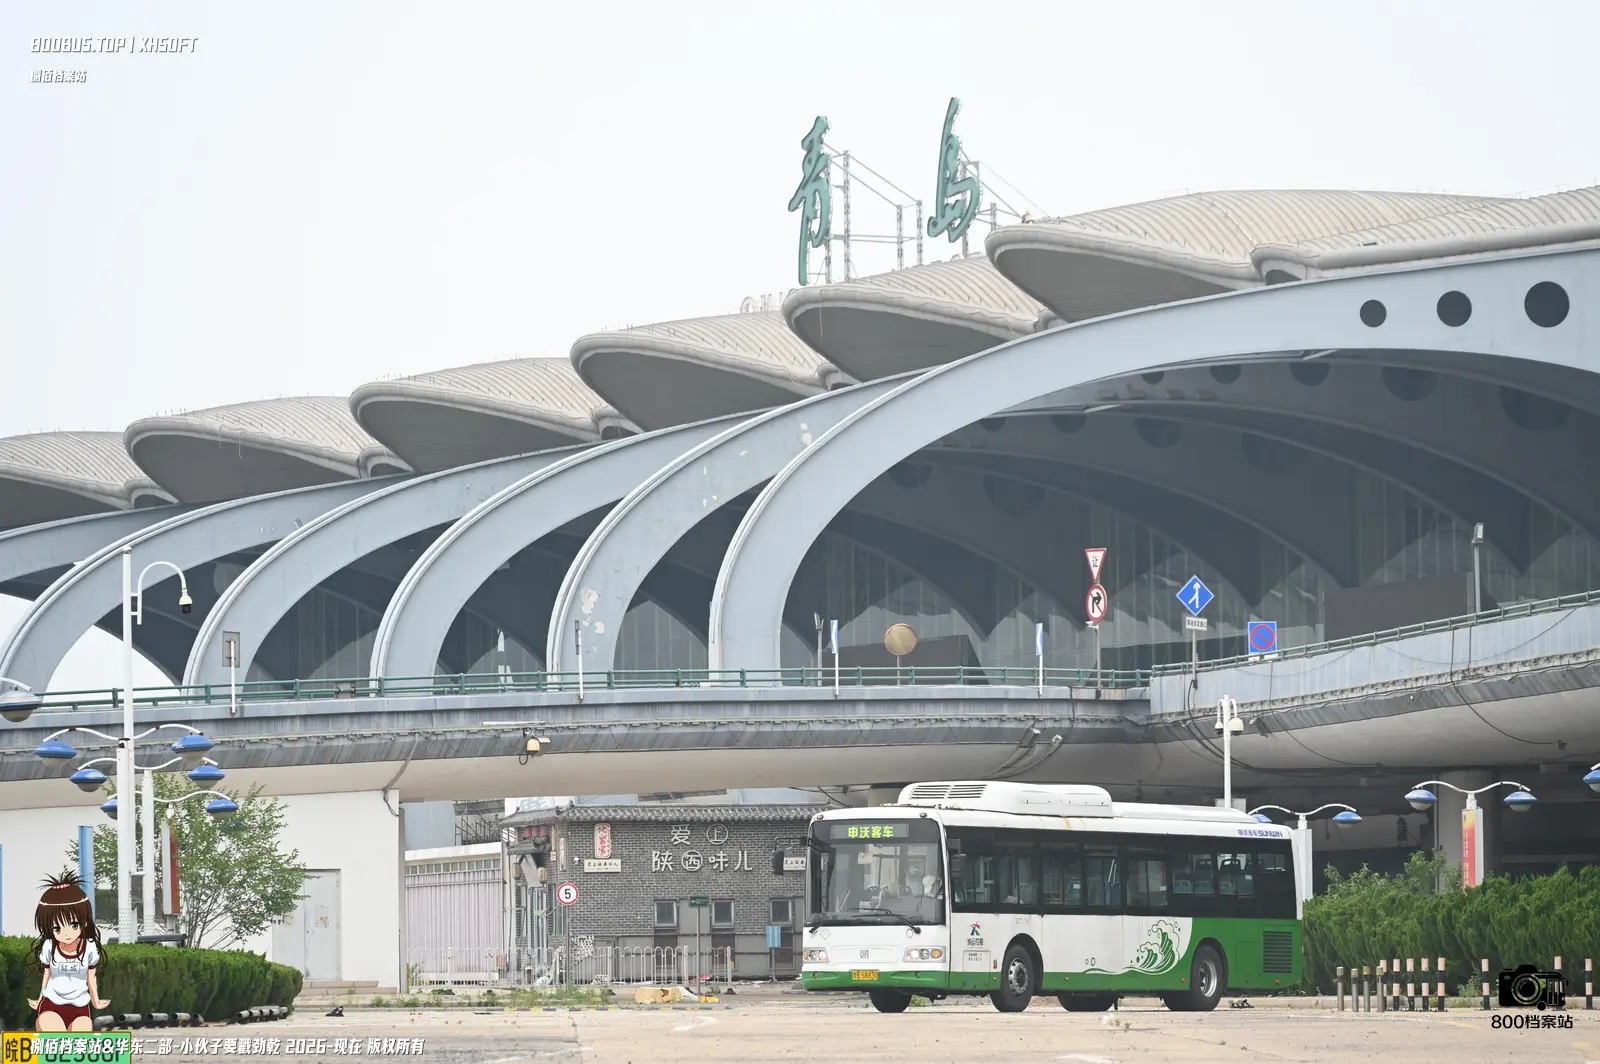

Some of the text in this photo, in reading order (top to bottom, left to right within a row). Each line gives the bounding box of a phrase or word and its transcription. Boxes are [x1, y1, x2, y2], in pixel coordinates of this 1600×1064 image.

[671, 824, 729, 845] 爱上
[848, 826, 894, 839] 申沃客车
[651, 850, 753, 872] 陕西味儿
[564, 888, 571, 900] 5
